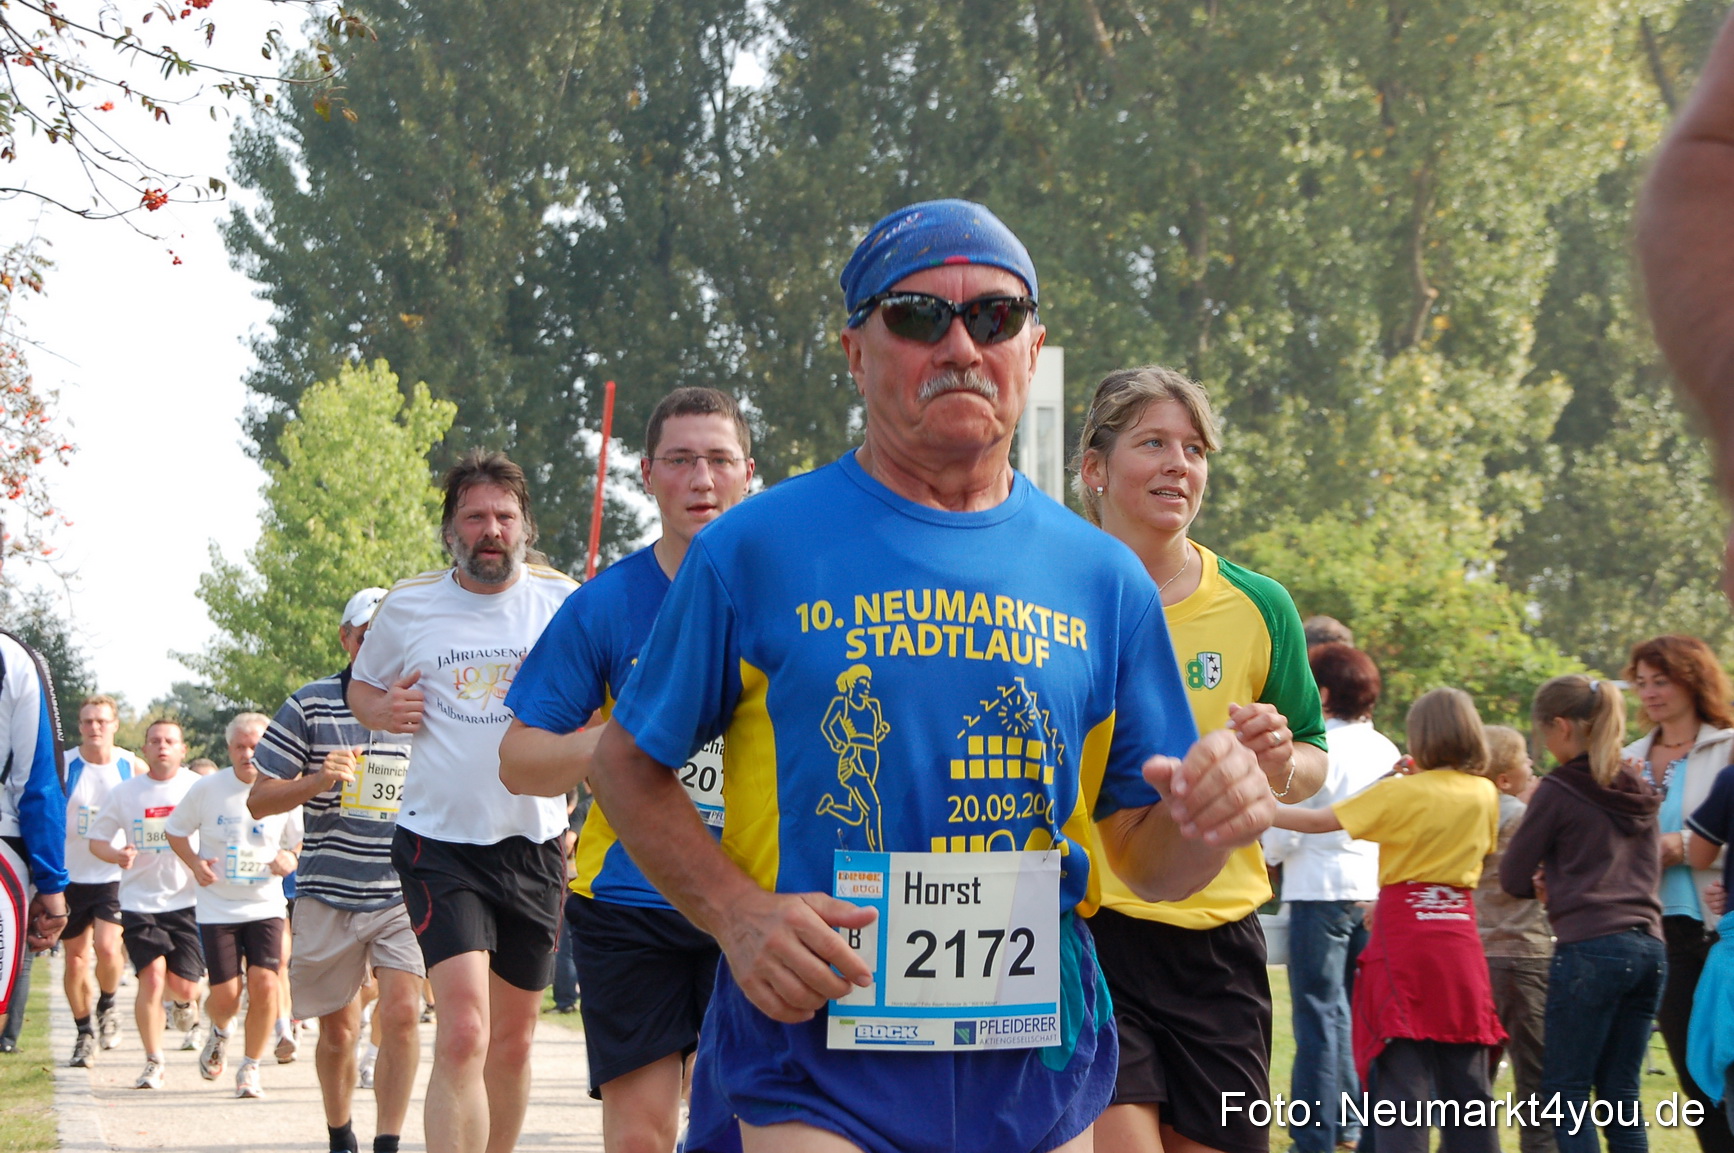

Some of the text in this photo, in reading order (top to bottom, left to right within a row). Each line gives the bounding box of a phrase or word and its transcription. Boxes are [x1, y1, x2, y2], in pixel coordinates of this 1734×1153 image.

[795, 588, 1088, 651] 10. NEUMARKTER
[845, 623, 1050, 668] STADTLAUF
[367, 762, 408, 777] Heinrich
[904, 871, 981, 905] Horst
[903, 927, 1036, 978] 2172
[855, 1024, 919, 1039] BOCK
[979, 1016, 1057, 1035] PFLEIDERER
[979, 1034, 1058, 1045] AKTIENGESELLSCHAFT
